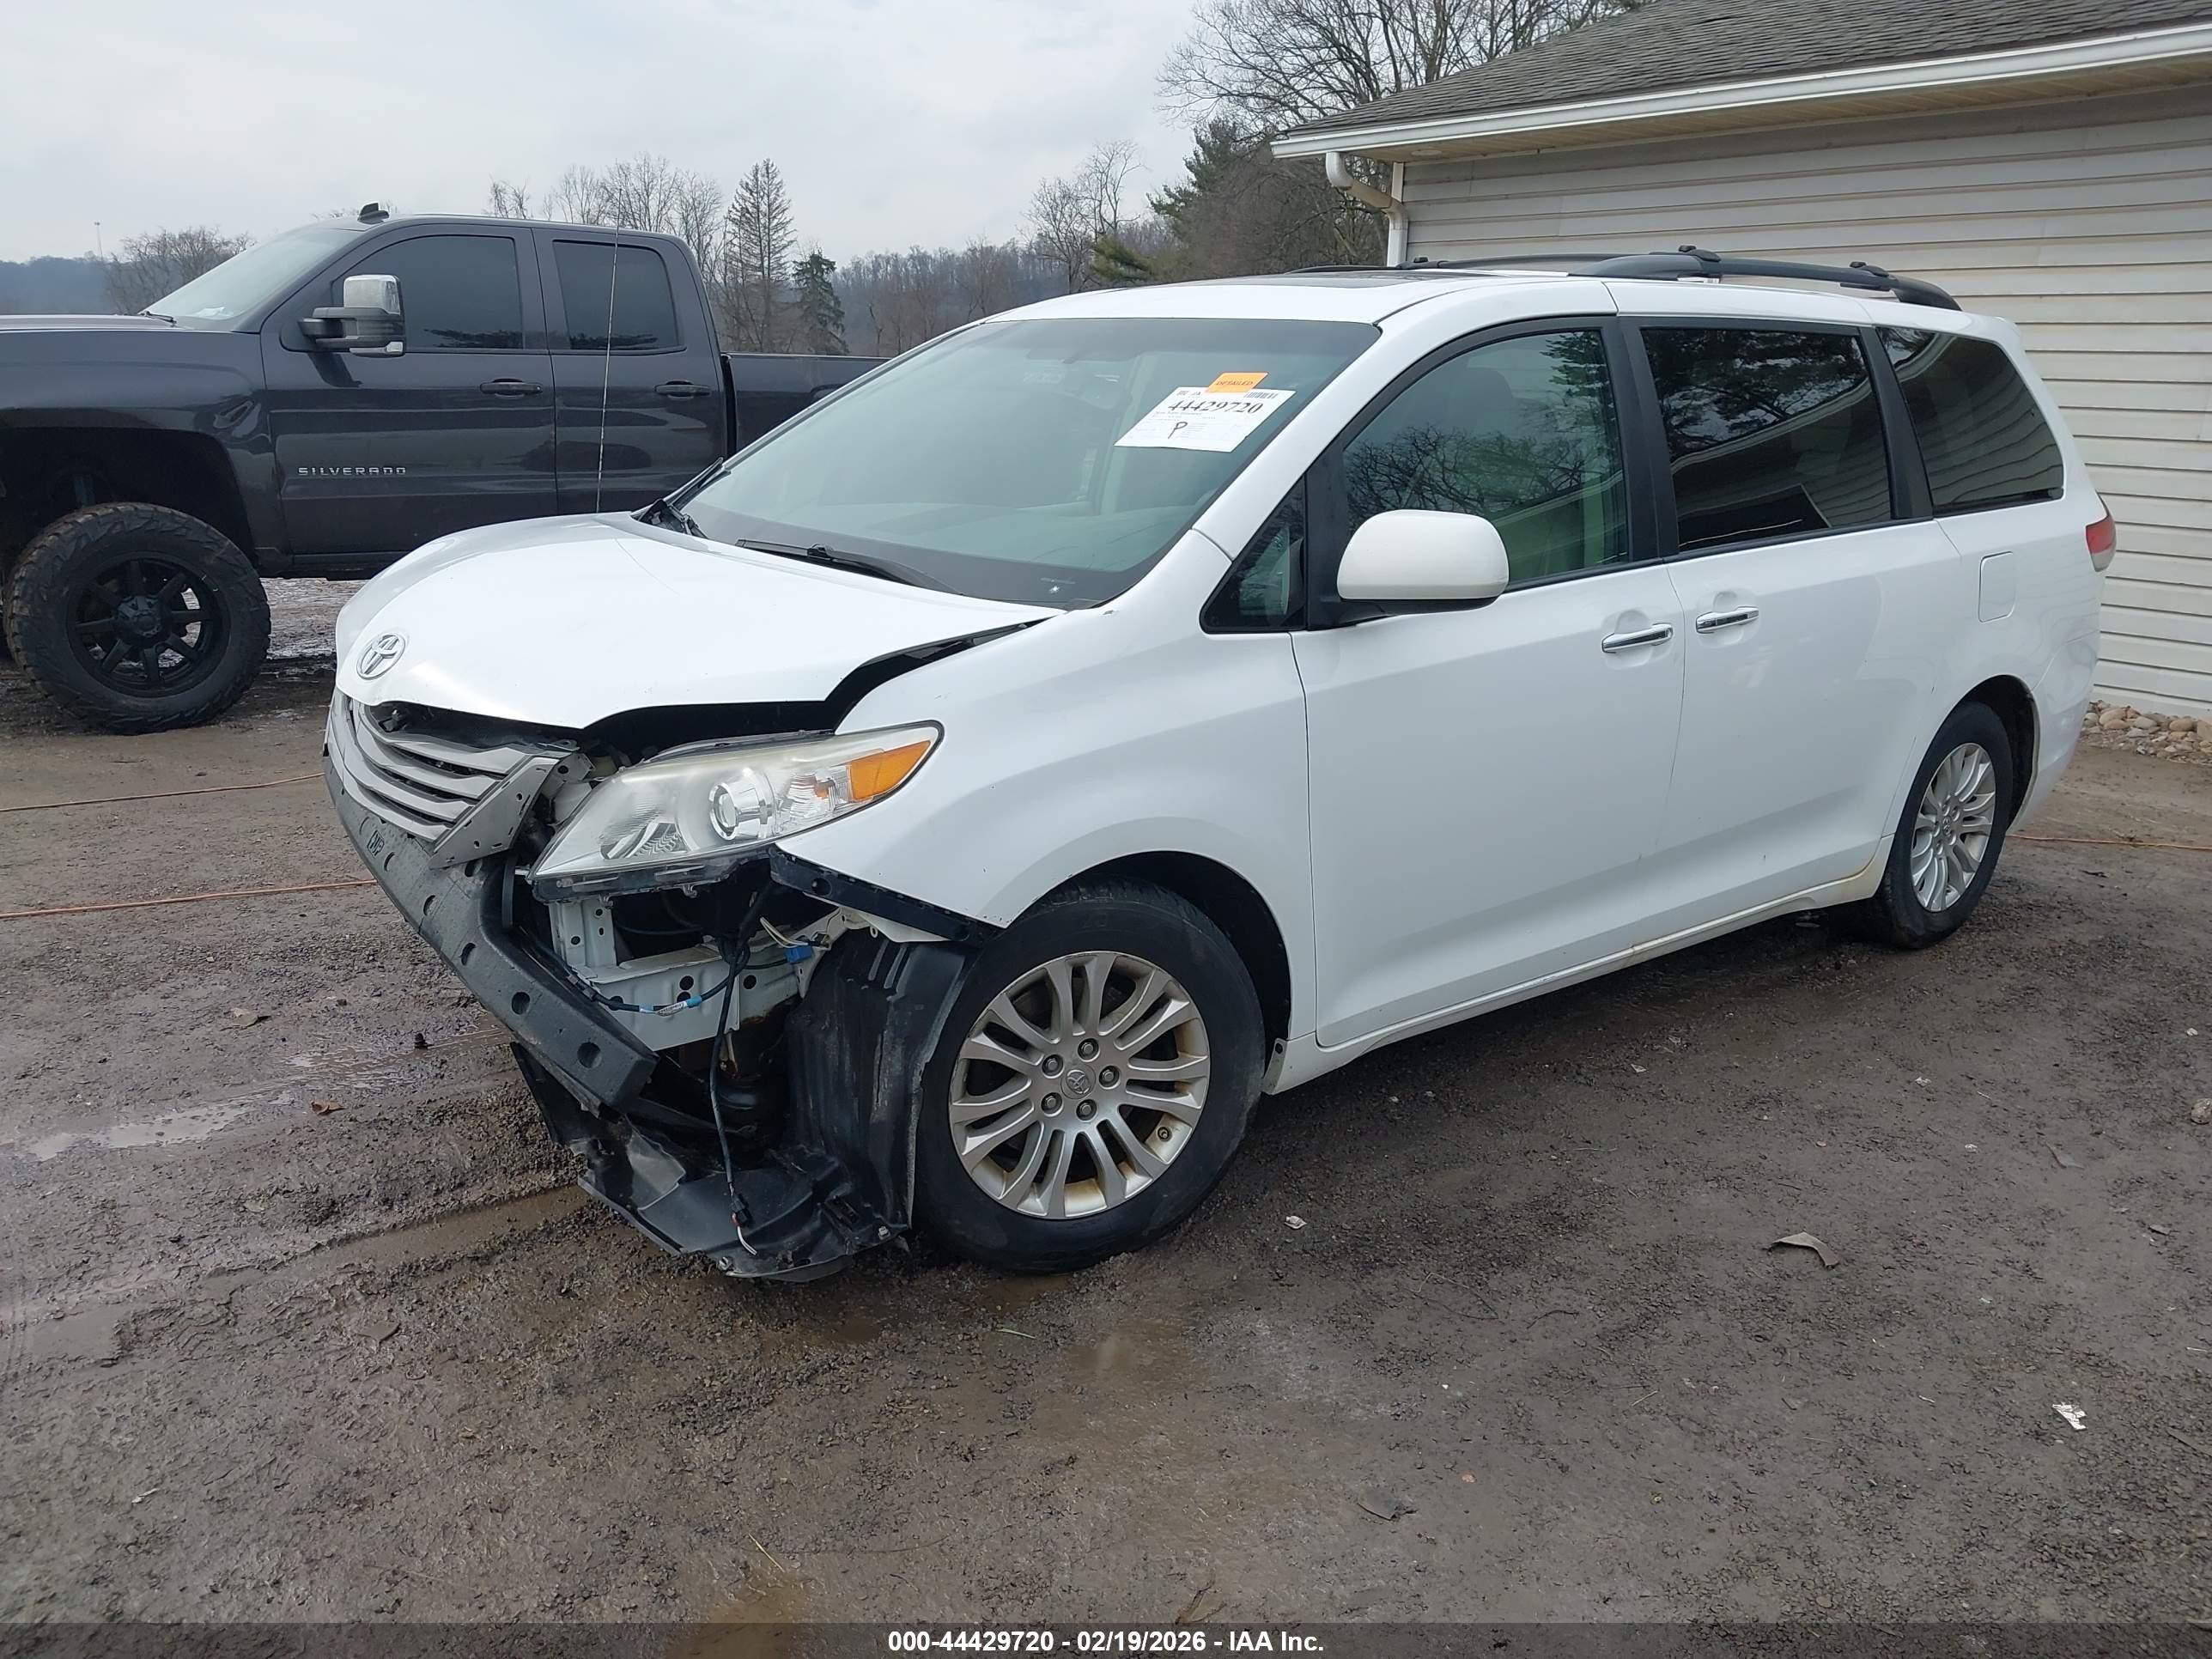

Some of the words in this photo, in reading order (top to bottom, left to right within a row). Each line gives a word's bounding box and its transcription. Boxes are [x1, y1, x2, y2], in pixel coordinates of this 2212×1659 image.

[1168, 399, 1264, 414] 44429720
[1168, 421, 1188, 440] P
[298, 467, 406, 476] SILVERADO
